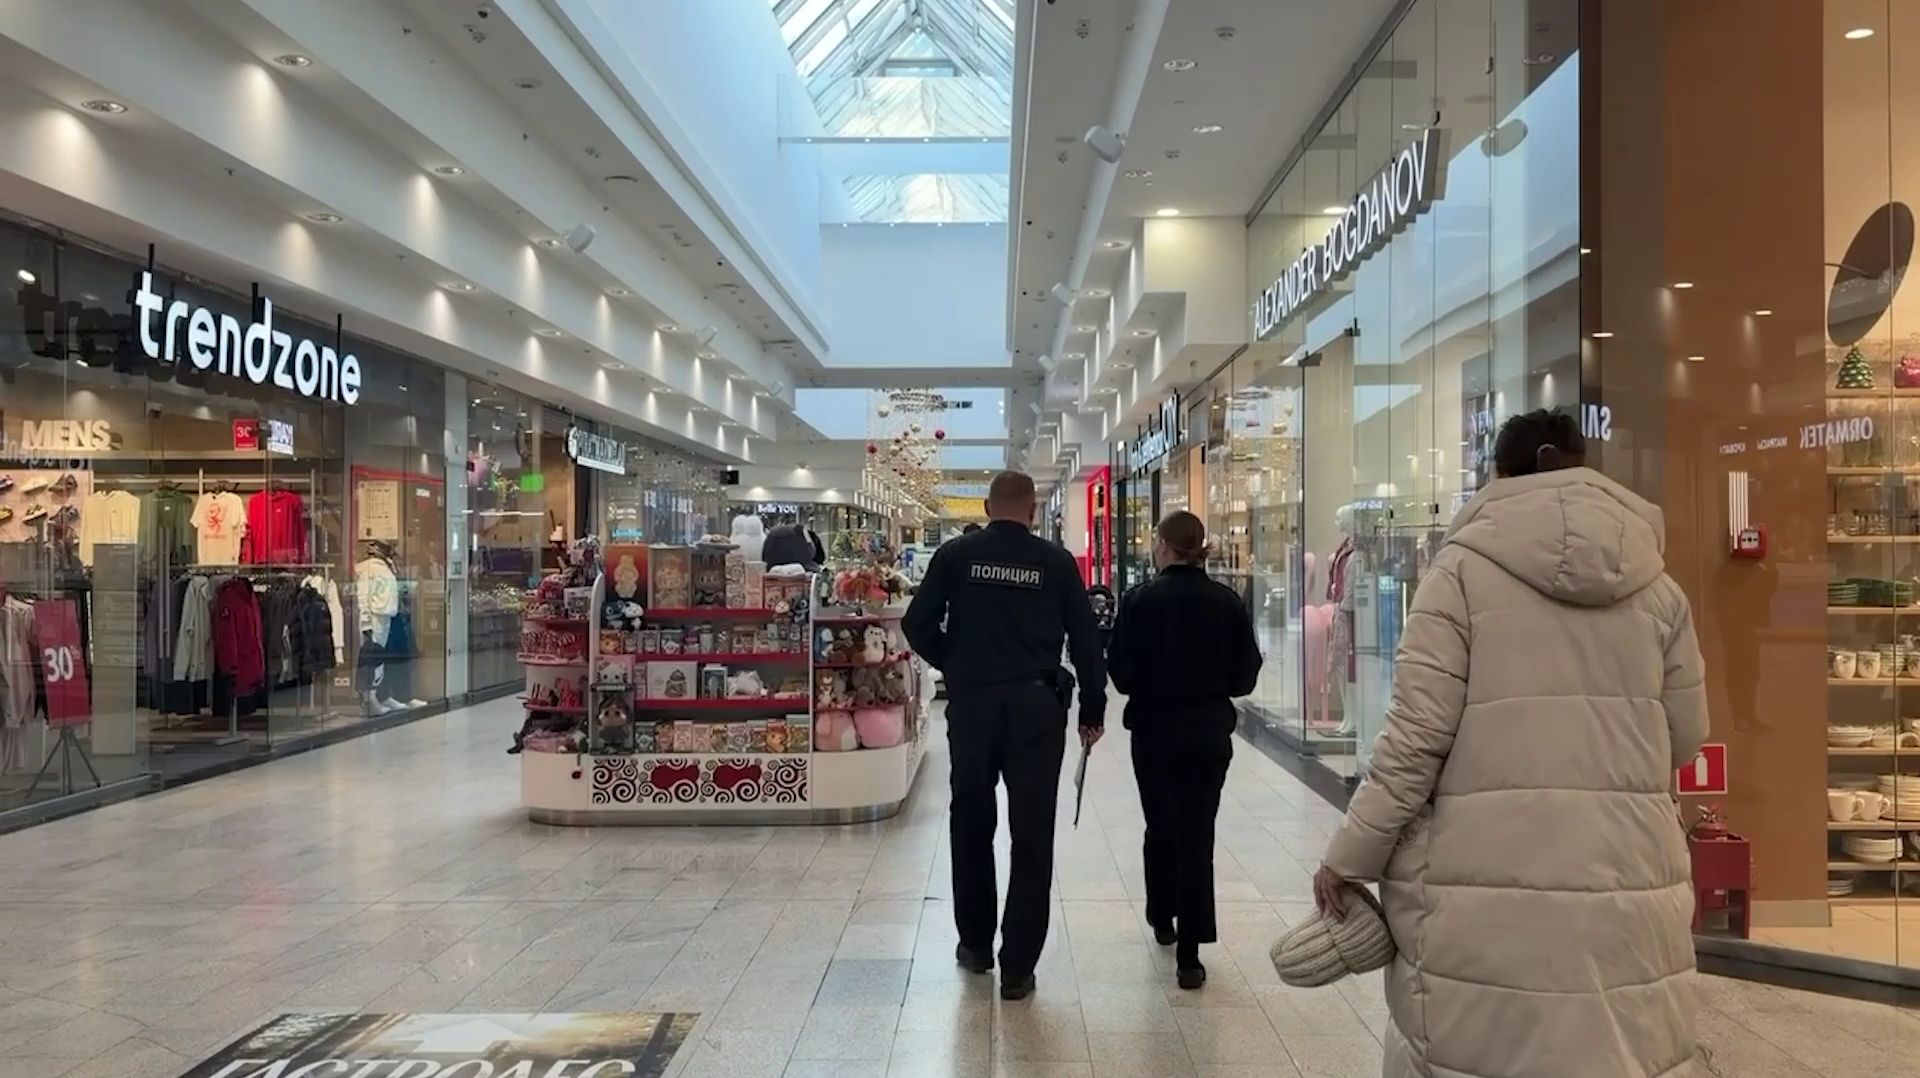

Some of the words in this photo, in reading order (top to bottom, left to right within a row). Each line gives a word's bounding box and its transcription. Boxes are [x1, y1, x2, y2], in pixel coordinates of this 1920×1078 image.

[1251, 245, 1318, 342] ALEXANDER
[1322, 128, 1429, 283] BOGDANOV
[136, 271, 362, 405] trendzone
[22, 419, 111, 451] MENS
[970, 564, 1041, 585] ПОЛИЦИЯ
